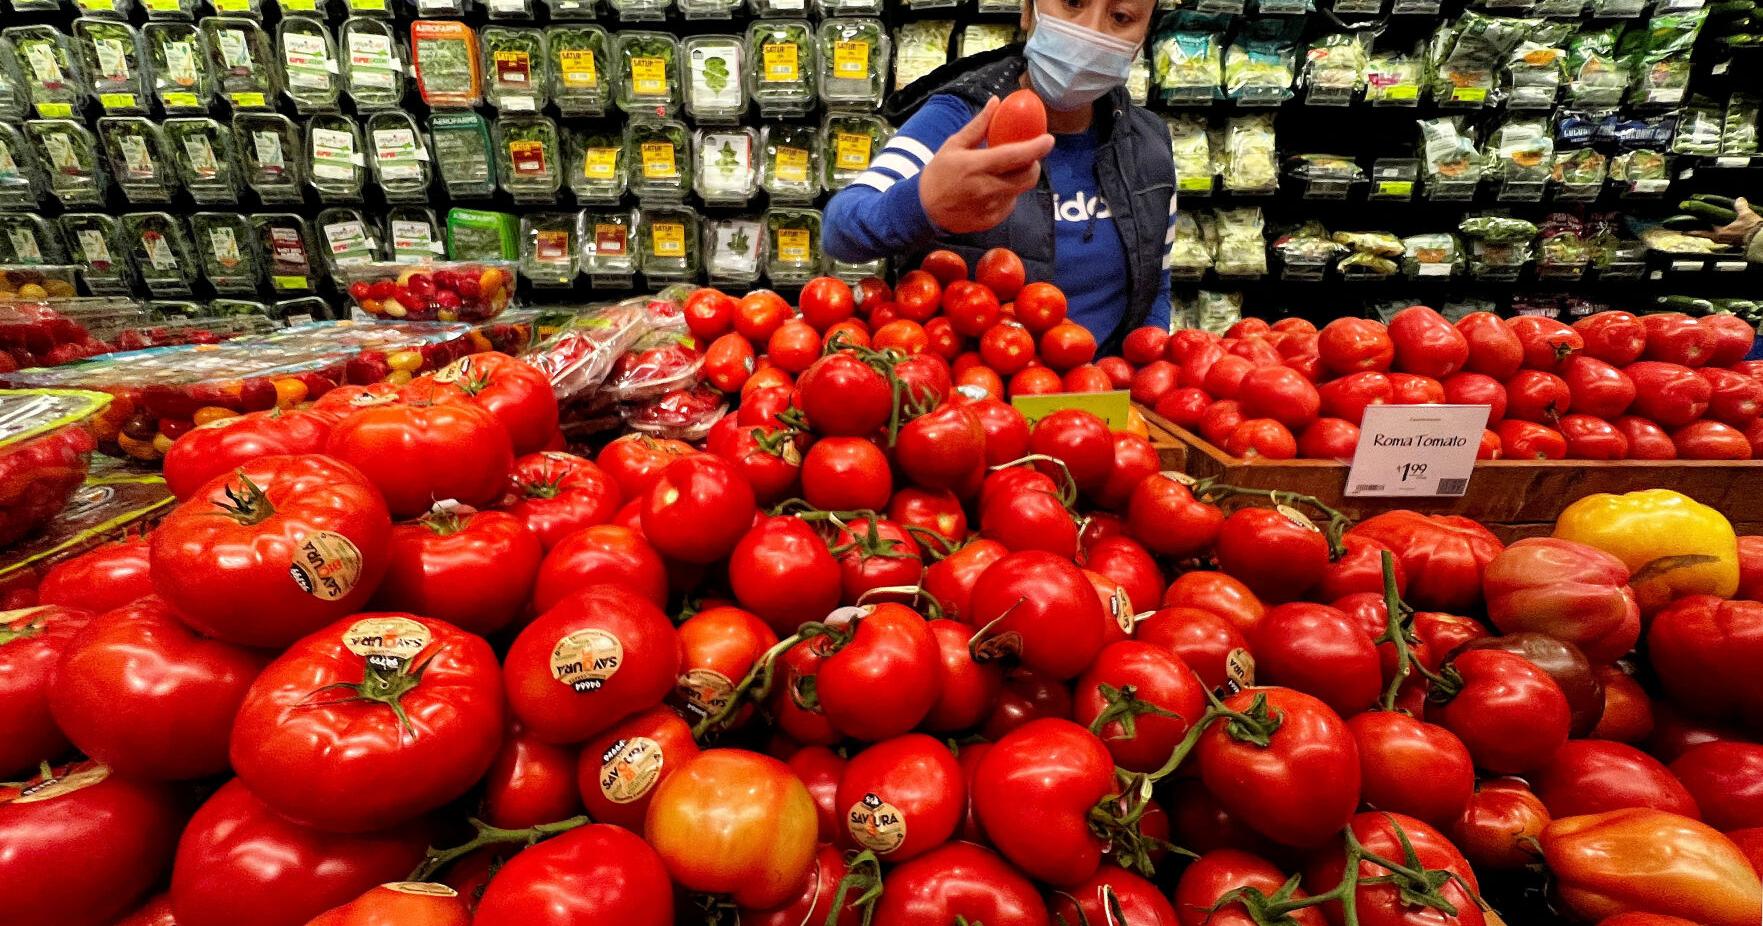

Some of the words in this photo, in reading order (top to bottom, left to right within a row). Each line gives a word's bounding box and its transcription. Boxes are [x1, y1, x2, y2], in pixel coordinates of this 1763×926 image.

[1374, 433, 1412, 447] Roma
[1416, 433, 1467, 447] Tomato
[556, 655, 618, 677] SAVOURA
[850, 811, 900, 827] SAVOURA
